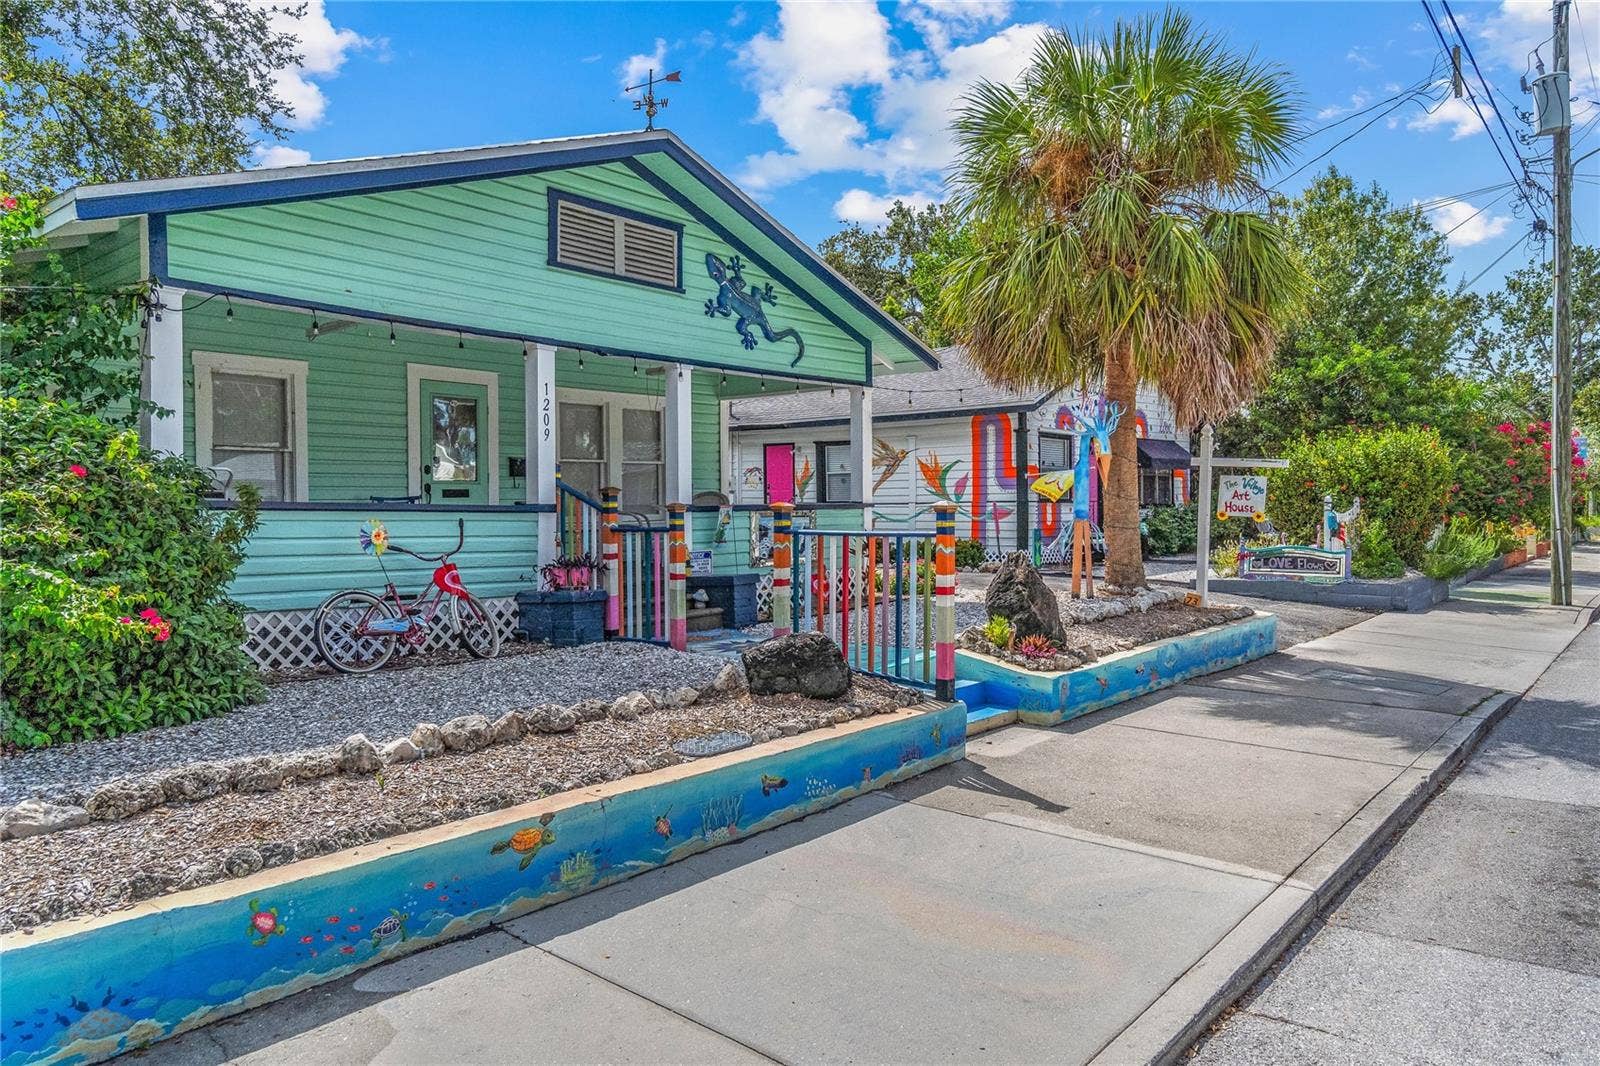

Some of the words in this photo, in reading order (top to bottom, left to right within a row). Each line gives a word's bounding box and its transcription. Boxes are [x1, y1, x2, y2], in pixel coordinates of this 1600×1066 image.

[1224, 480, 1238, 490] The
[1232, 489, 1251, 501] Art
[1224, 501, 1256, 513] House
[1262, 557, 1293, 569] LOVE
